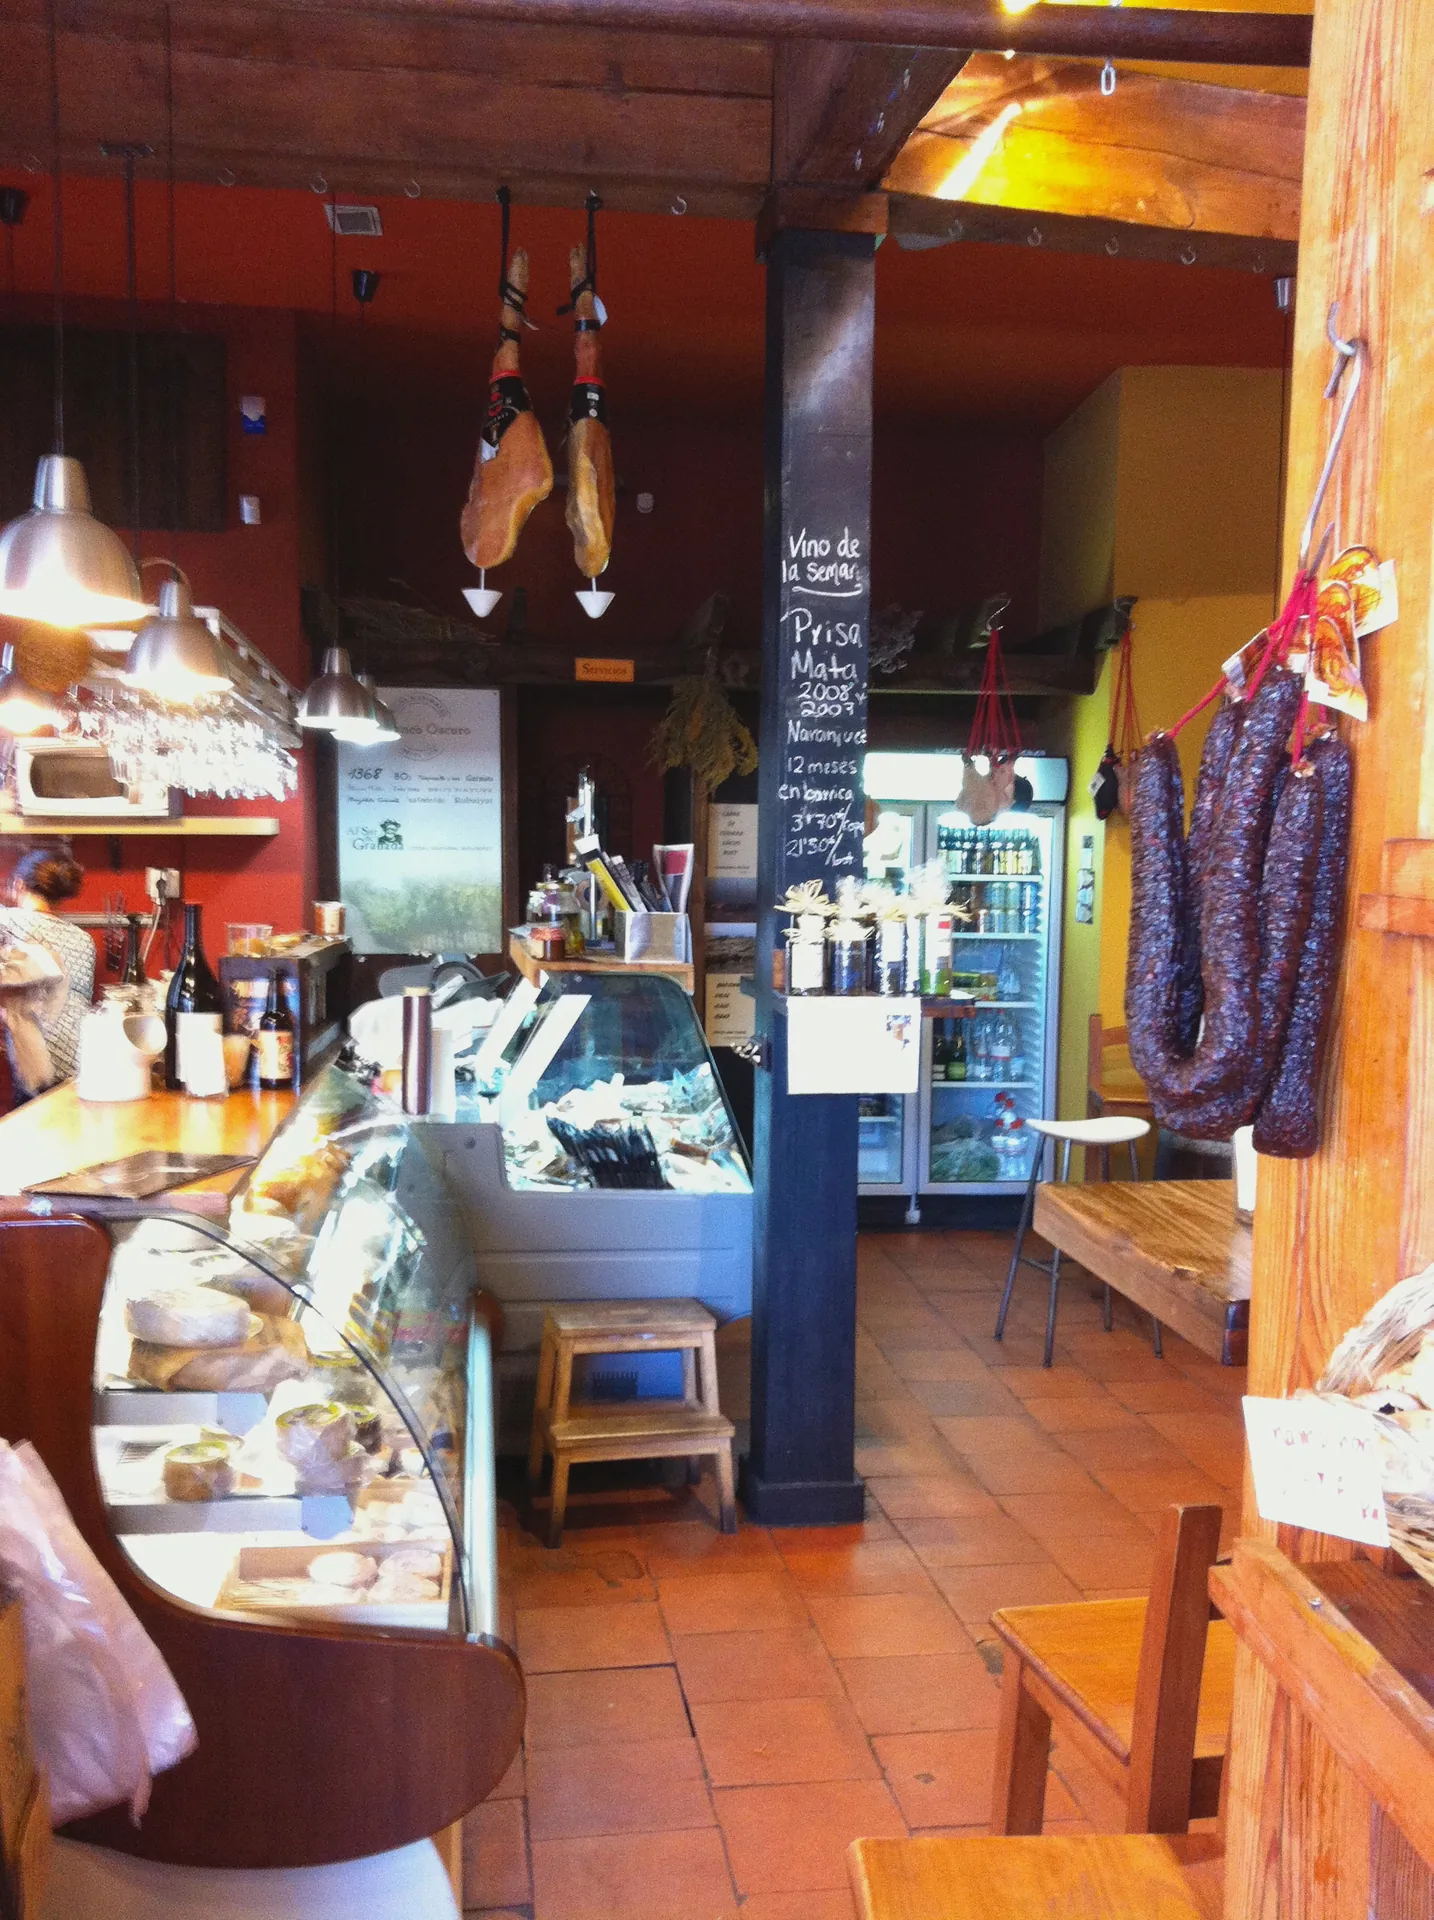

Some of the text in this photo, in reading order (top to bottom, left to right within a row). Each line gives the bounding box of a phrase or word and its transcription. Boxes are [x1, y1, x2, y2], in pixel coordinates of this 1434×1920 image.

[789, 525, 861, 559] Vino de
[781, 559, 801, 584] la
[790, 647, 859, 681] Mata
[797, 681, 854, 702] 2008
[799, 700, 855, 718] 2007
[347, 768, 384, 780] 1368
[787, 755, 858, 775] 12 meses
[777, 783, 801, 801] en
